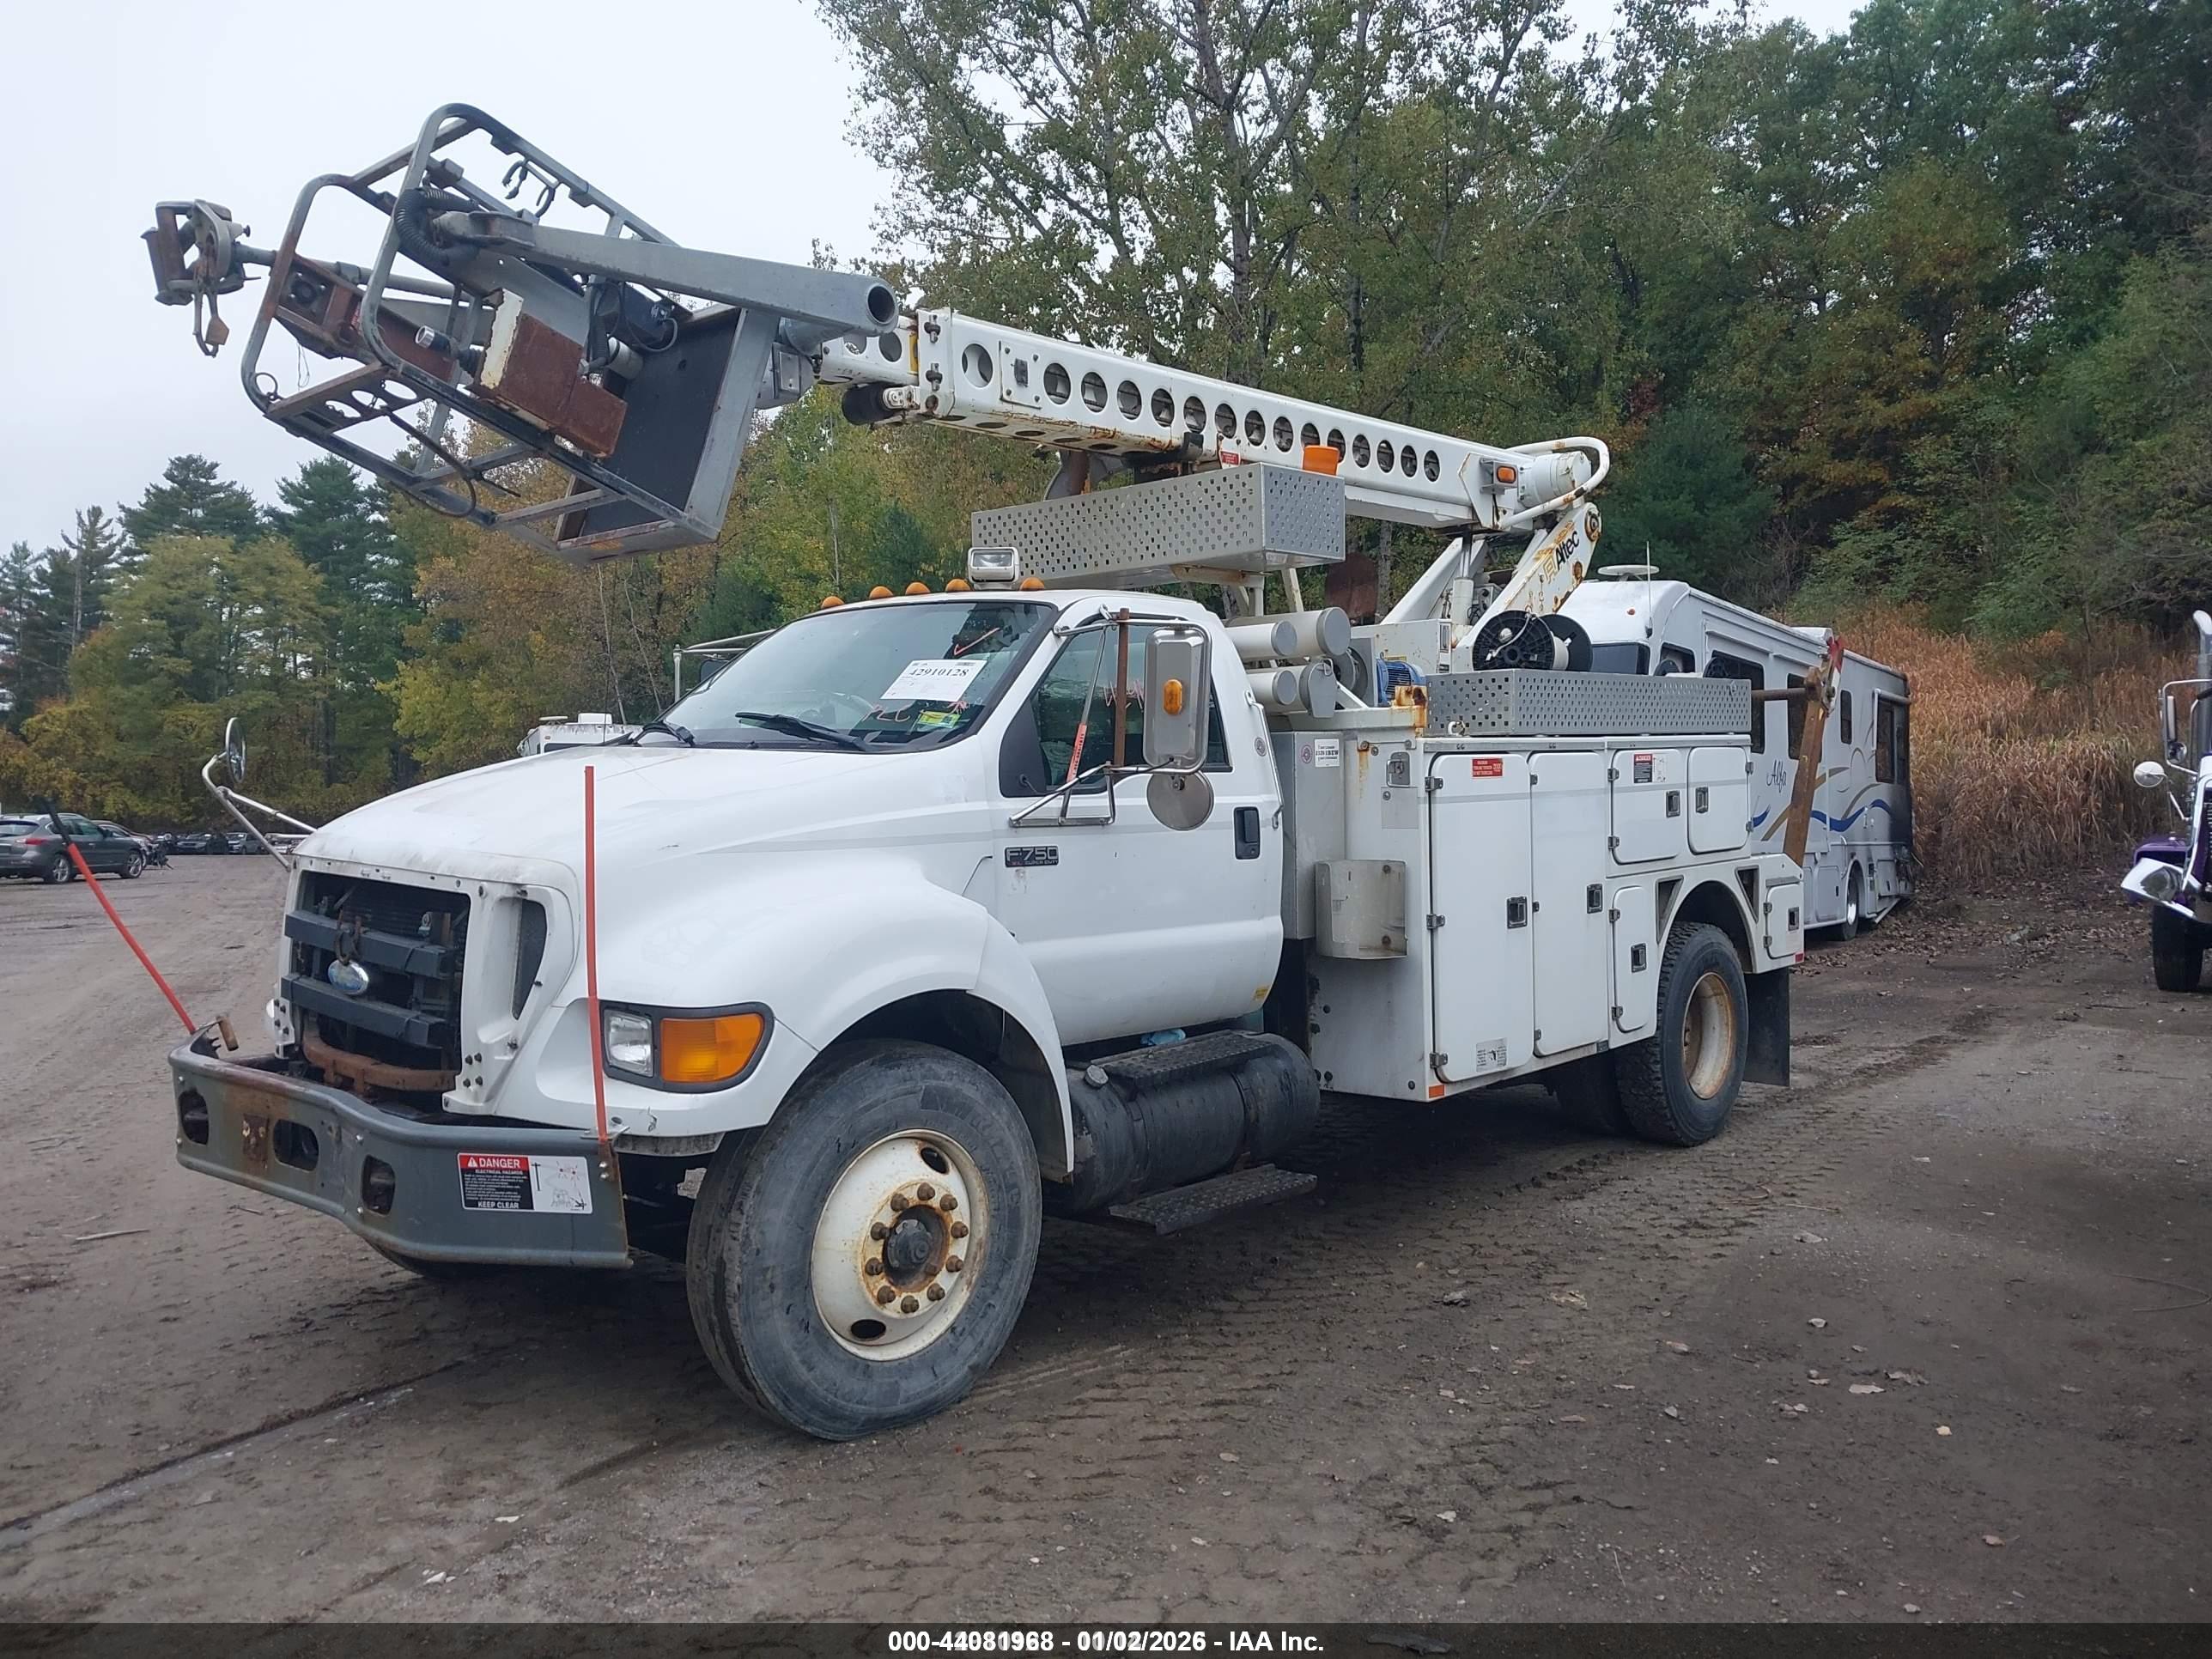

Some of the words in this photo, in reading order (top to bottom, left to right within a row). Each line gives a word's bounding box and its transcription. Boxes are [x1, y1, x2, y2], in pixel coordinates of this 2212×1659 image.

[1555, 531, 1579, 571] Altec
[908, 667, 969, 678] 42910128
[1766, 759, 1787, 793] Alfa
[478, 1158, 520, 1169] DANGER
